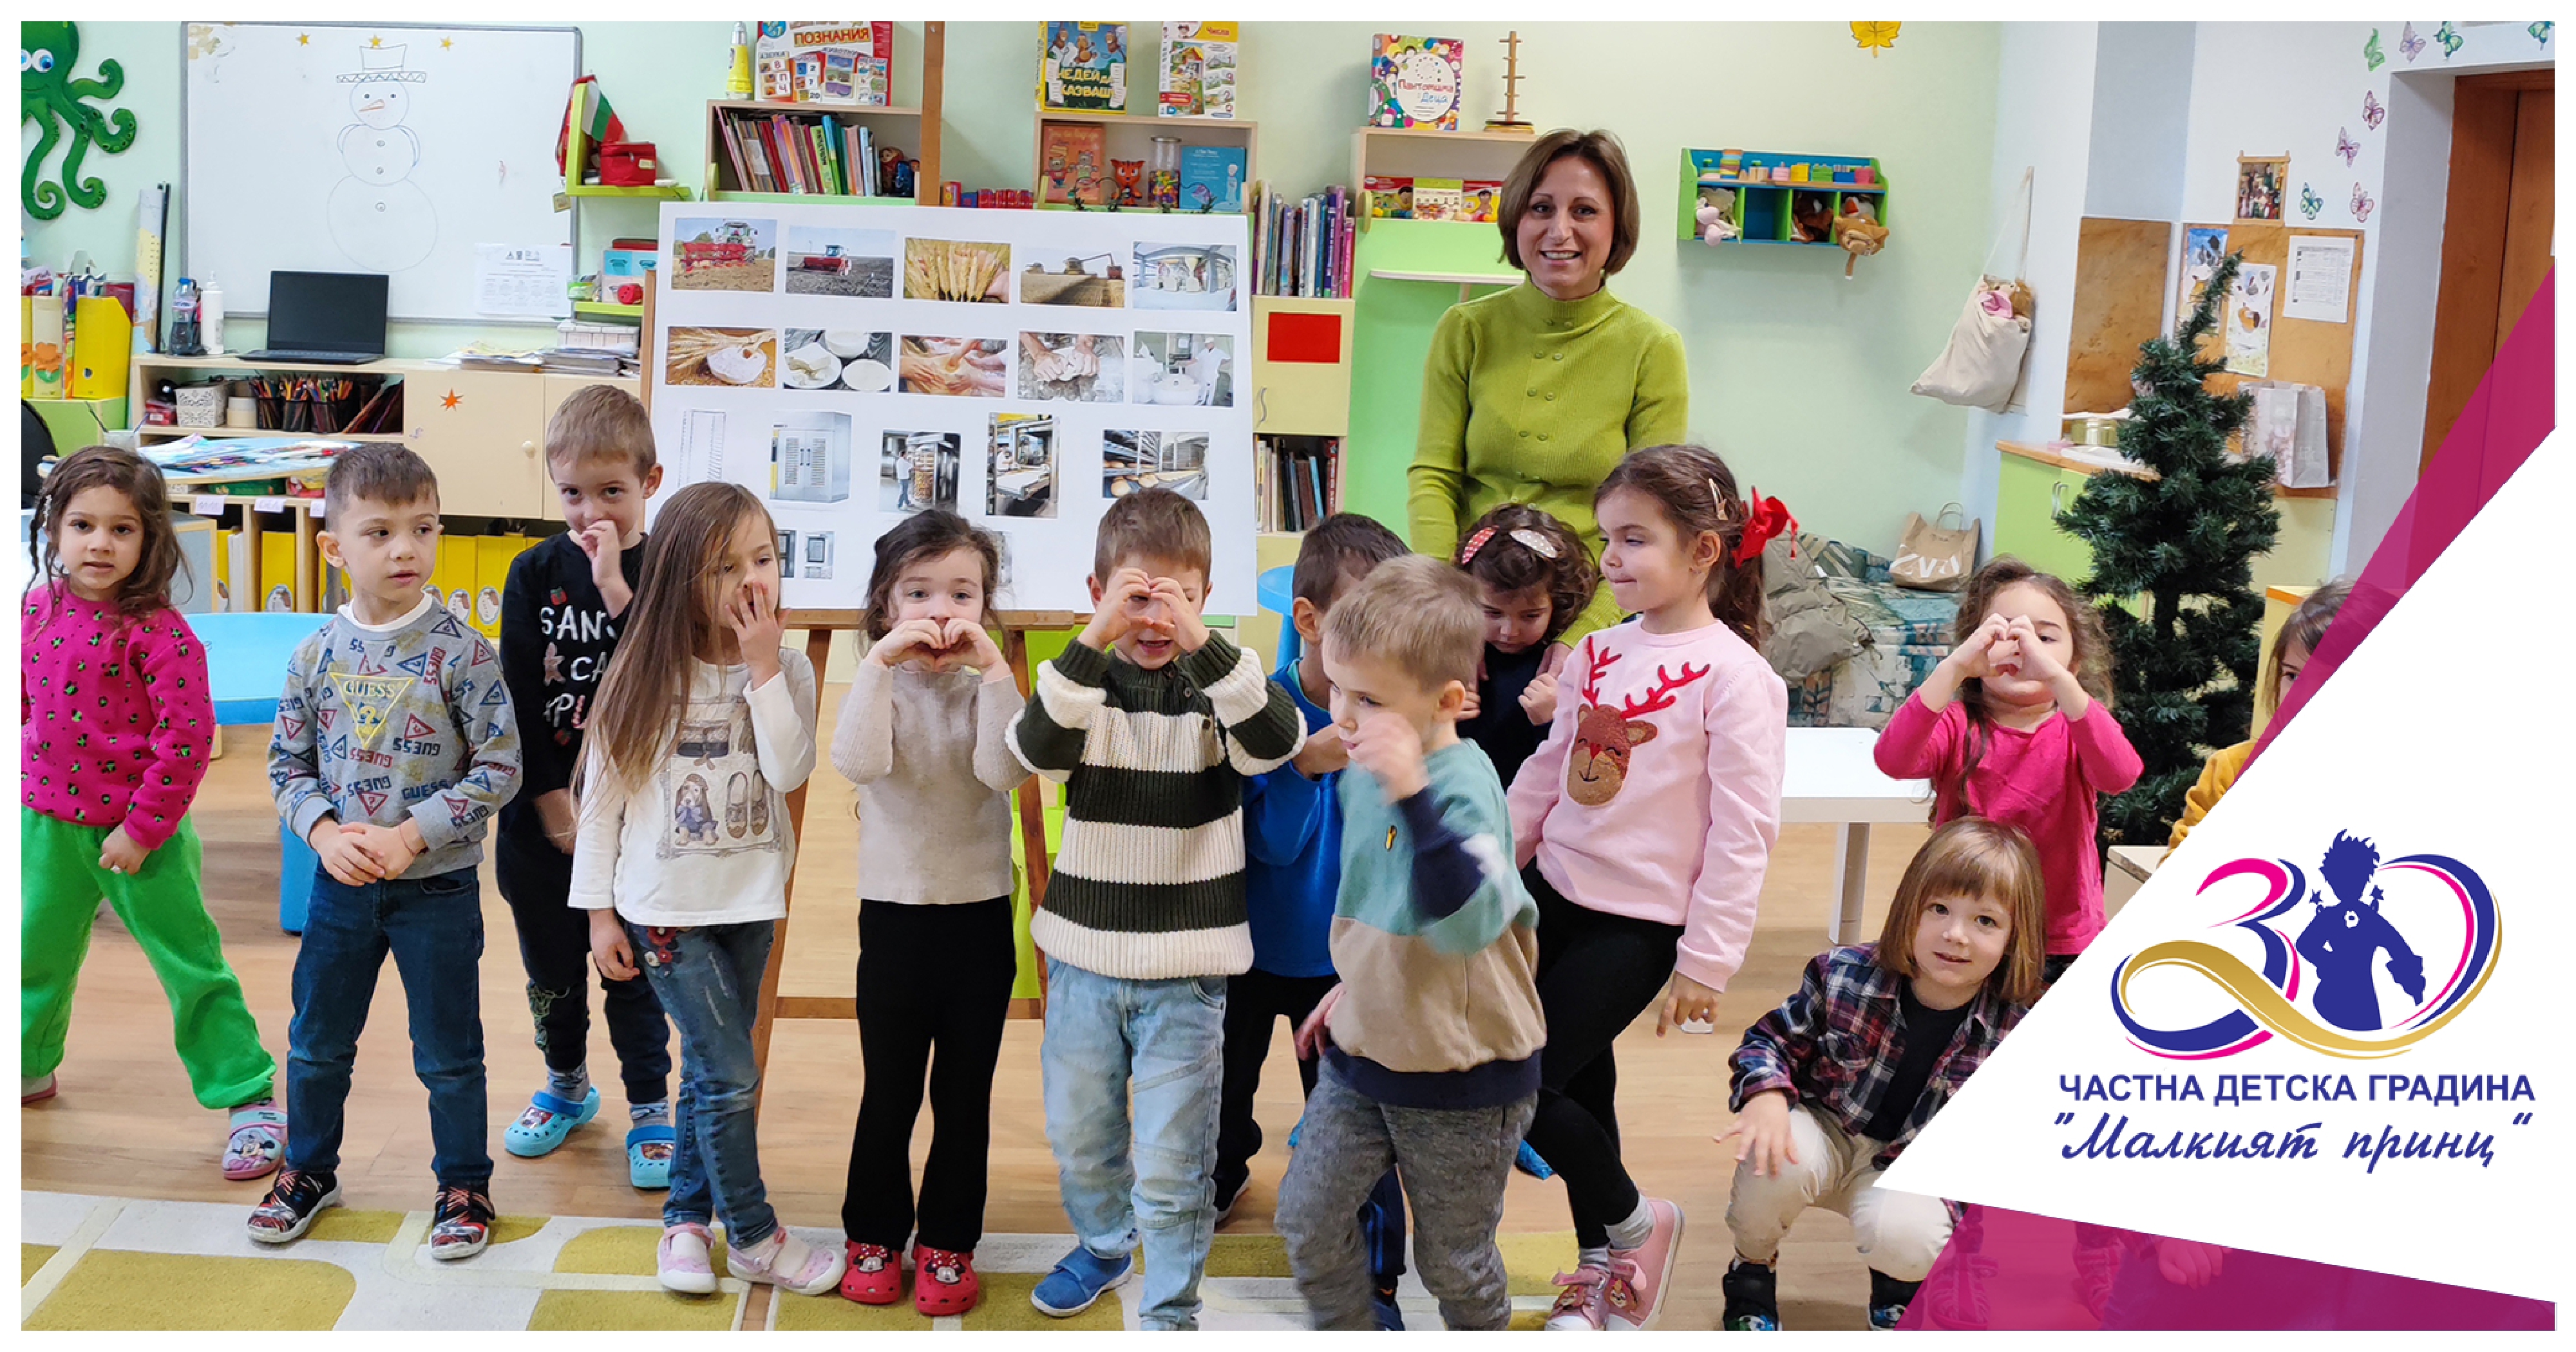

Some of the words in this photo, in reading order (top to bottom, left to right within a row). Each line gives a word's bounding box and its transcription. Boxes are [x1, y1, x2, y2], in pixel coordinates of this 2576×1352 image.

[793, 28, 870, 47] ПОЗНАНИЯ
[343, 679, 396, 699] GUESS
[392, 736, 440, 756] GUESS
[350, 747, 393, 768] GUESS
